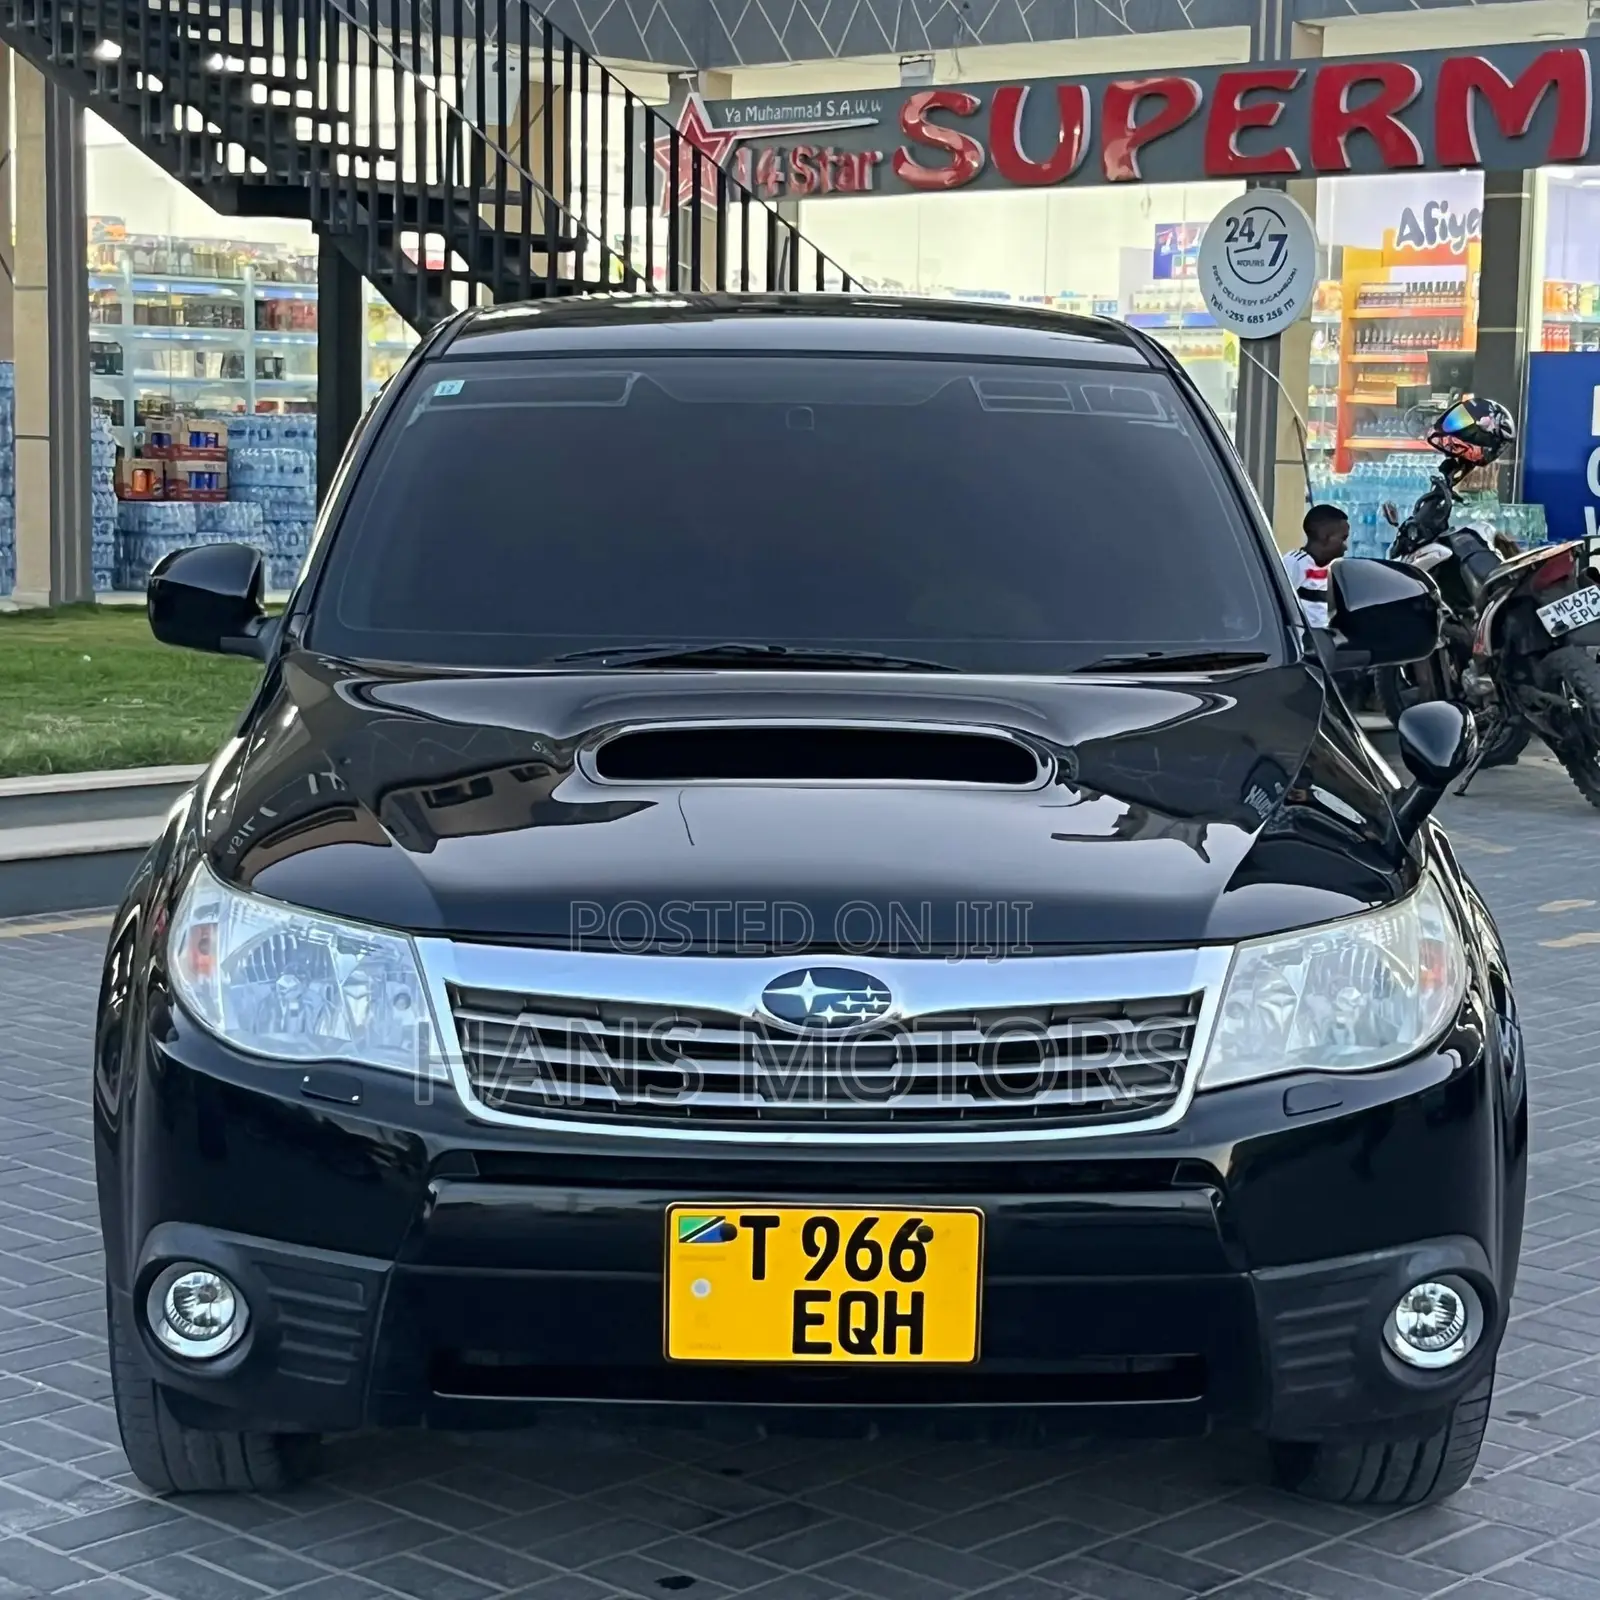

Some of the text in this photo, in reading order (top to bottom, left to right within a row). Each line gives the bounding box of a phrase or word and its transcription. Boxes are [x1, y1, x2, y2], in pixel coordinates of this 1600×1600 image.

[725, 107, 741, 123] Ya
[745, 101, 822, 122] Muhammad
[892, 47, 1593, 190] SUPERM
[1222, 285, 1258, 306] DELIVERY
[1552, 587, 1600, 617] MC675
[739, 1214, 928, 1283] T 966
[792, 1289, 925, 1355] EQH
